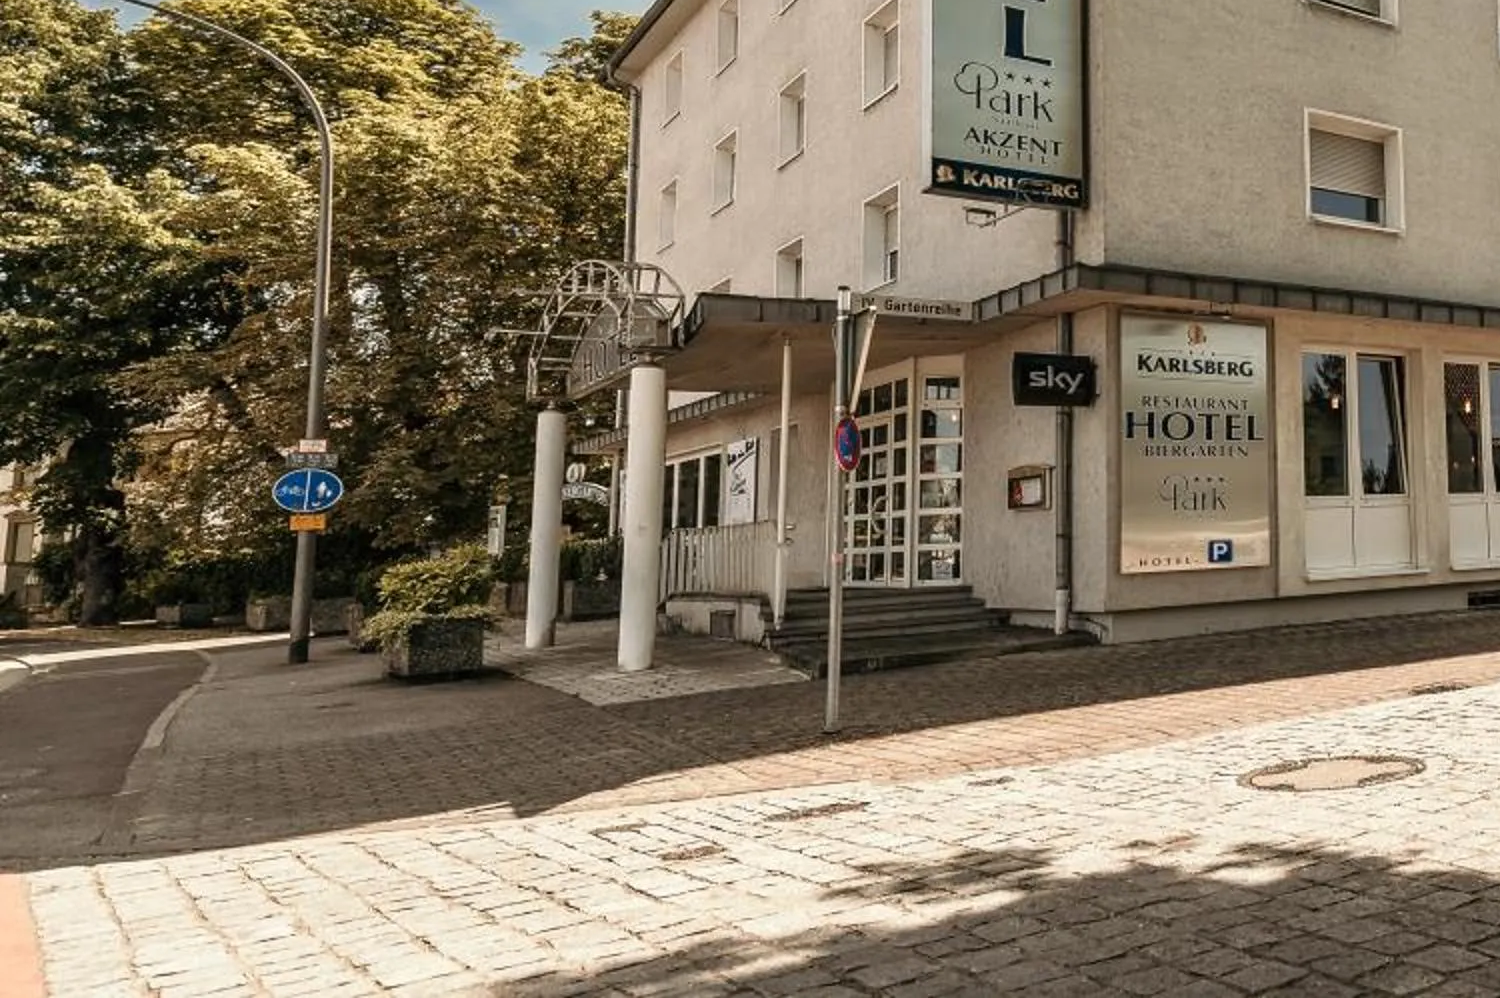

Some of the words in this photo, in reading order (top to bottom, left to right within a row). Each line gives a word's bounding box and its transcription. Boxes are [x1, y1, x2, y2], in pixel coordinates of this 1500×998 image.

[954, 62, 1053, 123] Park
[964, 127, 1063, 157] AKZENT
[884, 299, 961, 316] Gartenreihe
[1029, 364, 1083, 395] sky
[1137, 354, 1253, 377] KARLSBERG
[1141, 395, 1249, 411] RESTAURANT
[1125, 411, 1265, 441] HOTEL
[1144, 444, 1249, 458] BIERGARTEN
[1160, 474, 1229, 511] Park
